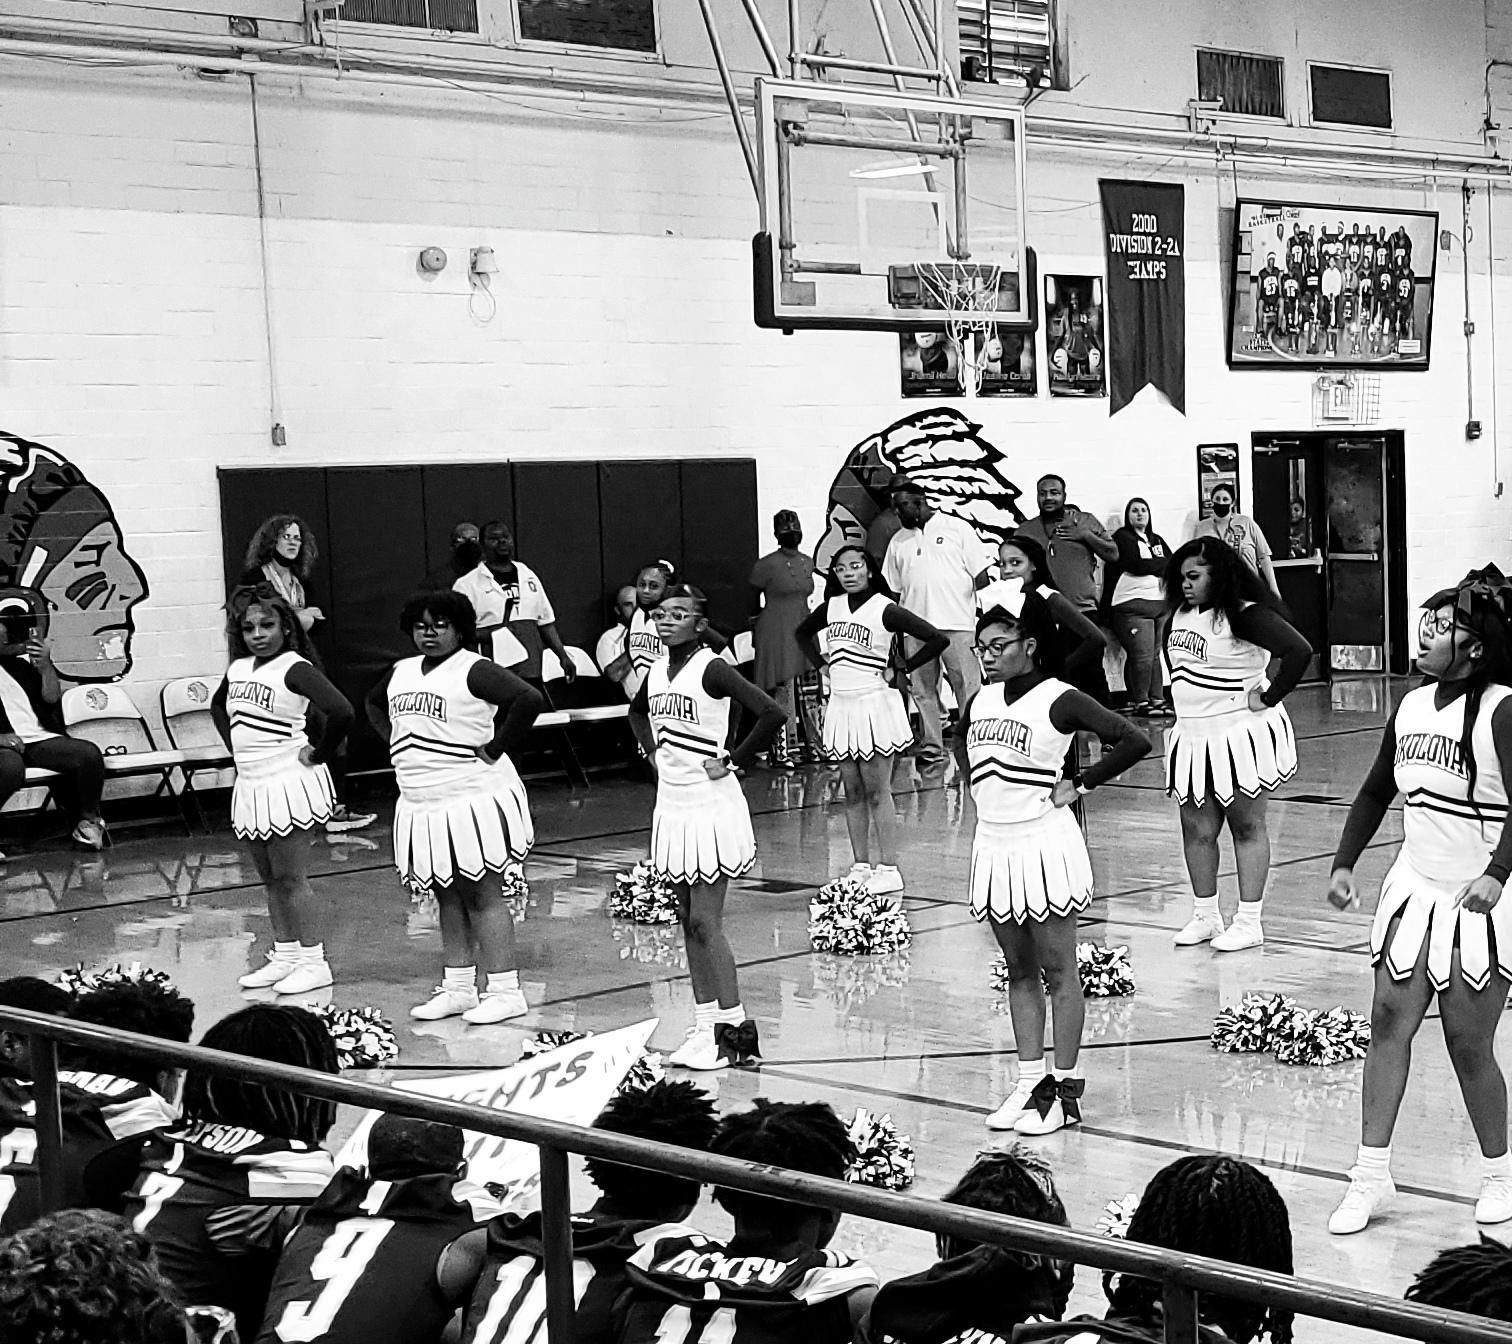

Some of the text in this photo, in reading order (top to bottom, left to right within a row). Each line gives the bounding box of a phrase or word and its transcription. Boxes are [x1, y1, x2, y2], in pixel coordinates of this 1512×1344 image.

[1131, 213, 1157, 233] 2000
[1109, 234, 1153, 255] DIVISION
[274, 1218, 396, 1343] 9
